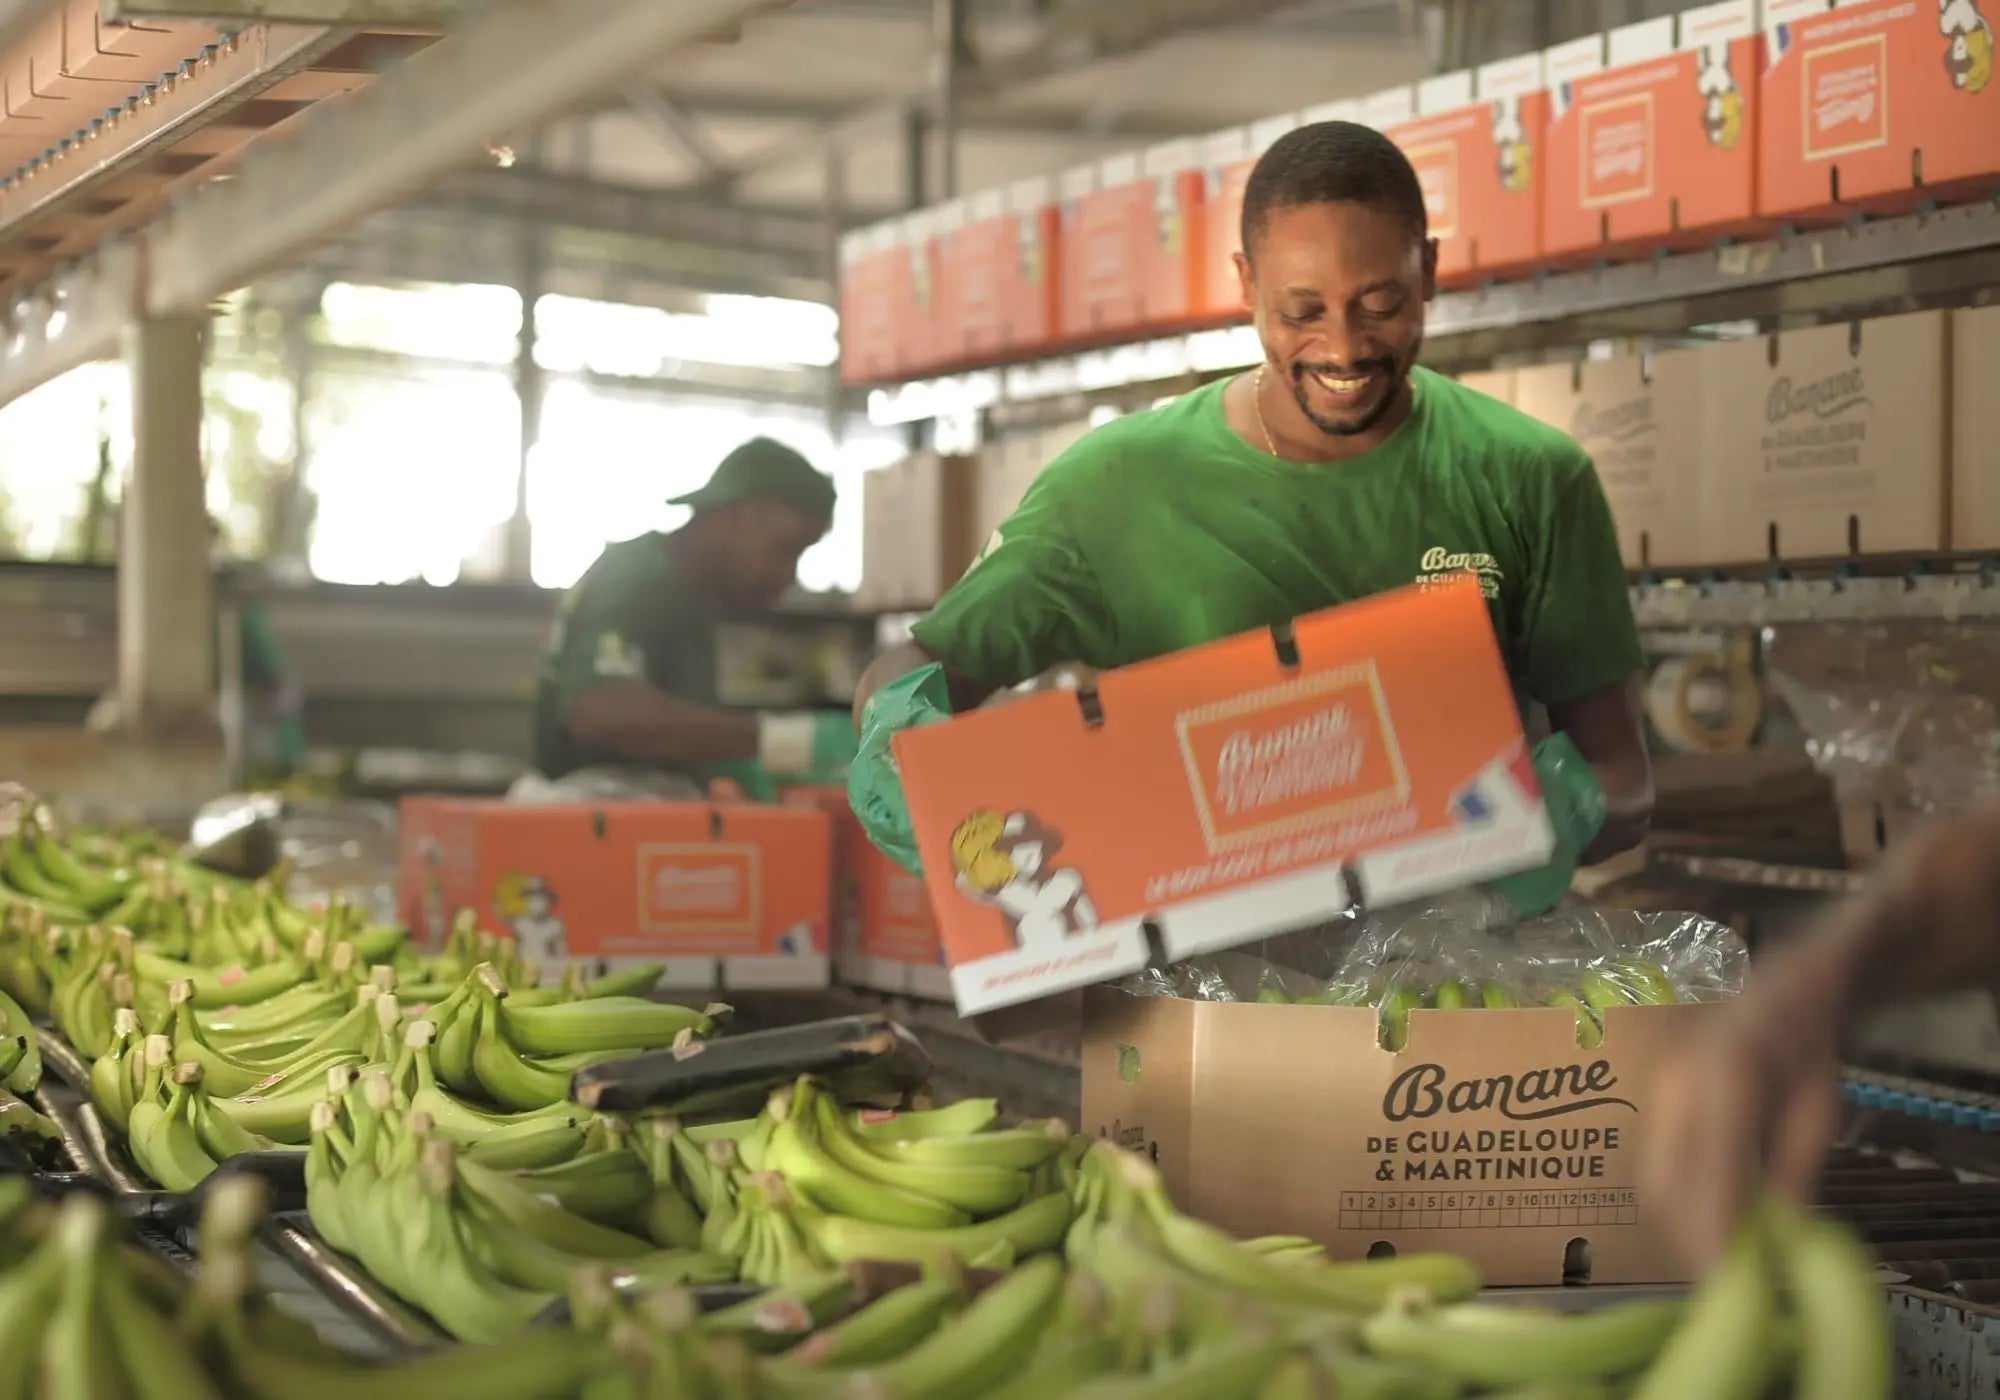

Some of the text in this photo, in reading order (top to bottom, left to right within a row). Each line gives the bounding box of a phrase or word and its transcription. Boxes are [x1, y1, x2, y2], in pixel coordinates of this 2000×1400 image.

[1382, 1060, 1638, 1122] Banane
[1367, 1128, 1619, 1154] DE GUADELOUPE
[1375, 1156, 1604, 1181] & MARTINIQUE
[1348, 1197, 1354, 1208] 1
[1368, 1197, 1376, 1208] 2
[1388, 1197, 1395, 1208] 3
[1407, 1197, 1415, 1208] 4
[1427, 1196, 1435, 1207] 5
[1467, 1196, 1475, 1207] 7
[1487, 1196, 1495, 1207] 8
[1507, 1195, 1514, 1206] 9
[1524, 1194, 1538, 1206] 10
[1544, 1194, 1556, 1205] 11
[1563, 1194, 1577, 1205] 12
[1583, 1193, 1596, 1204] 13
[1602, 1193, 1615, 1204] 14
[1621, 1193, 1634, 1204] 15
